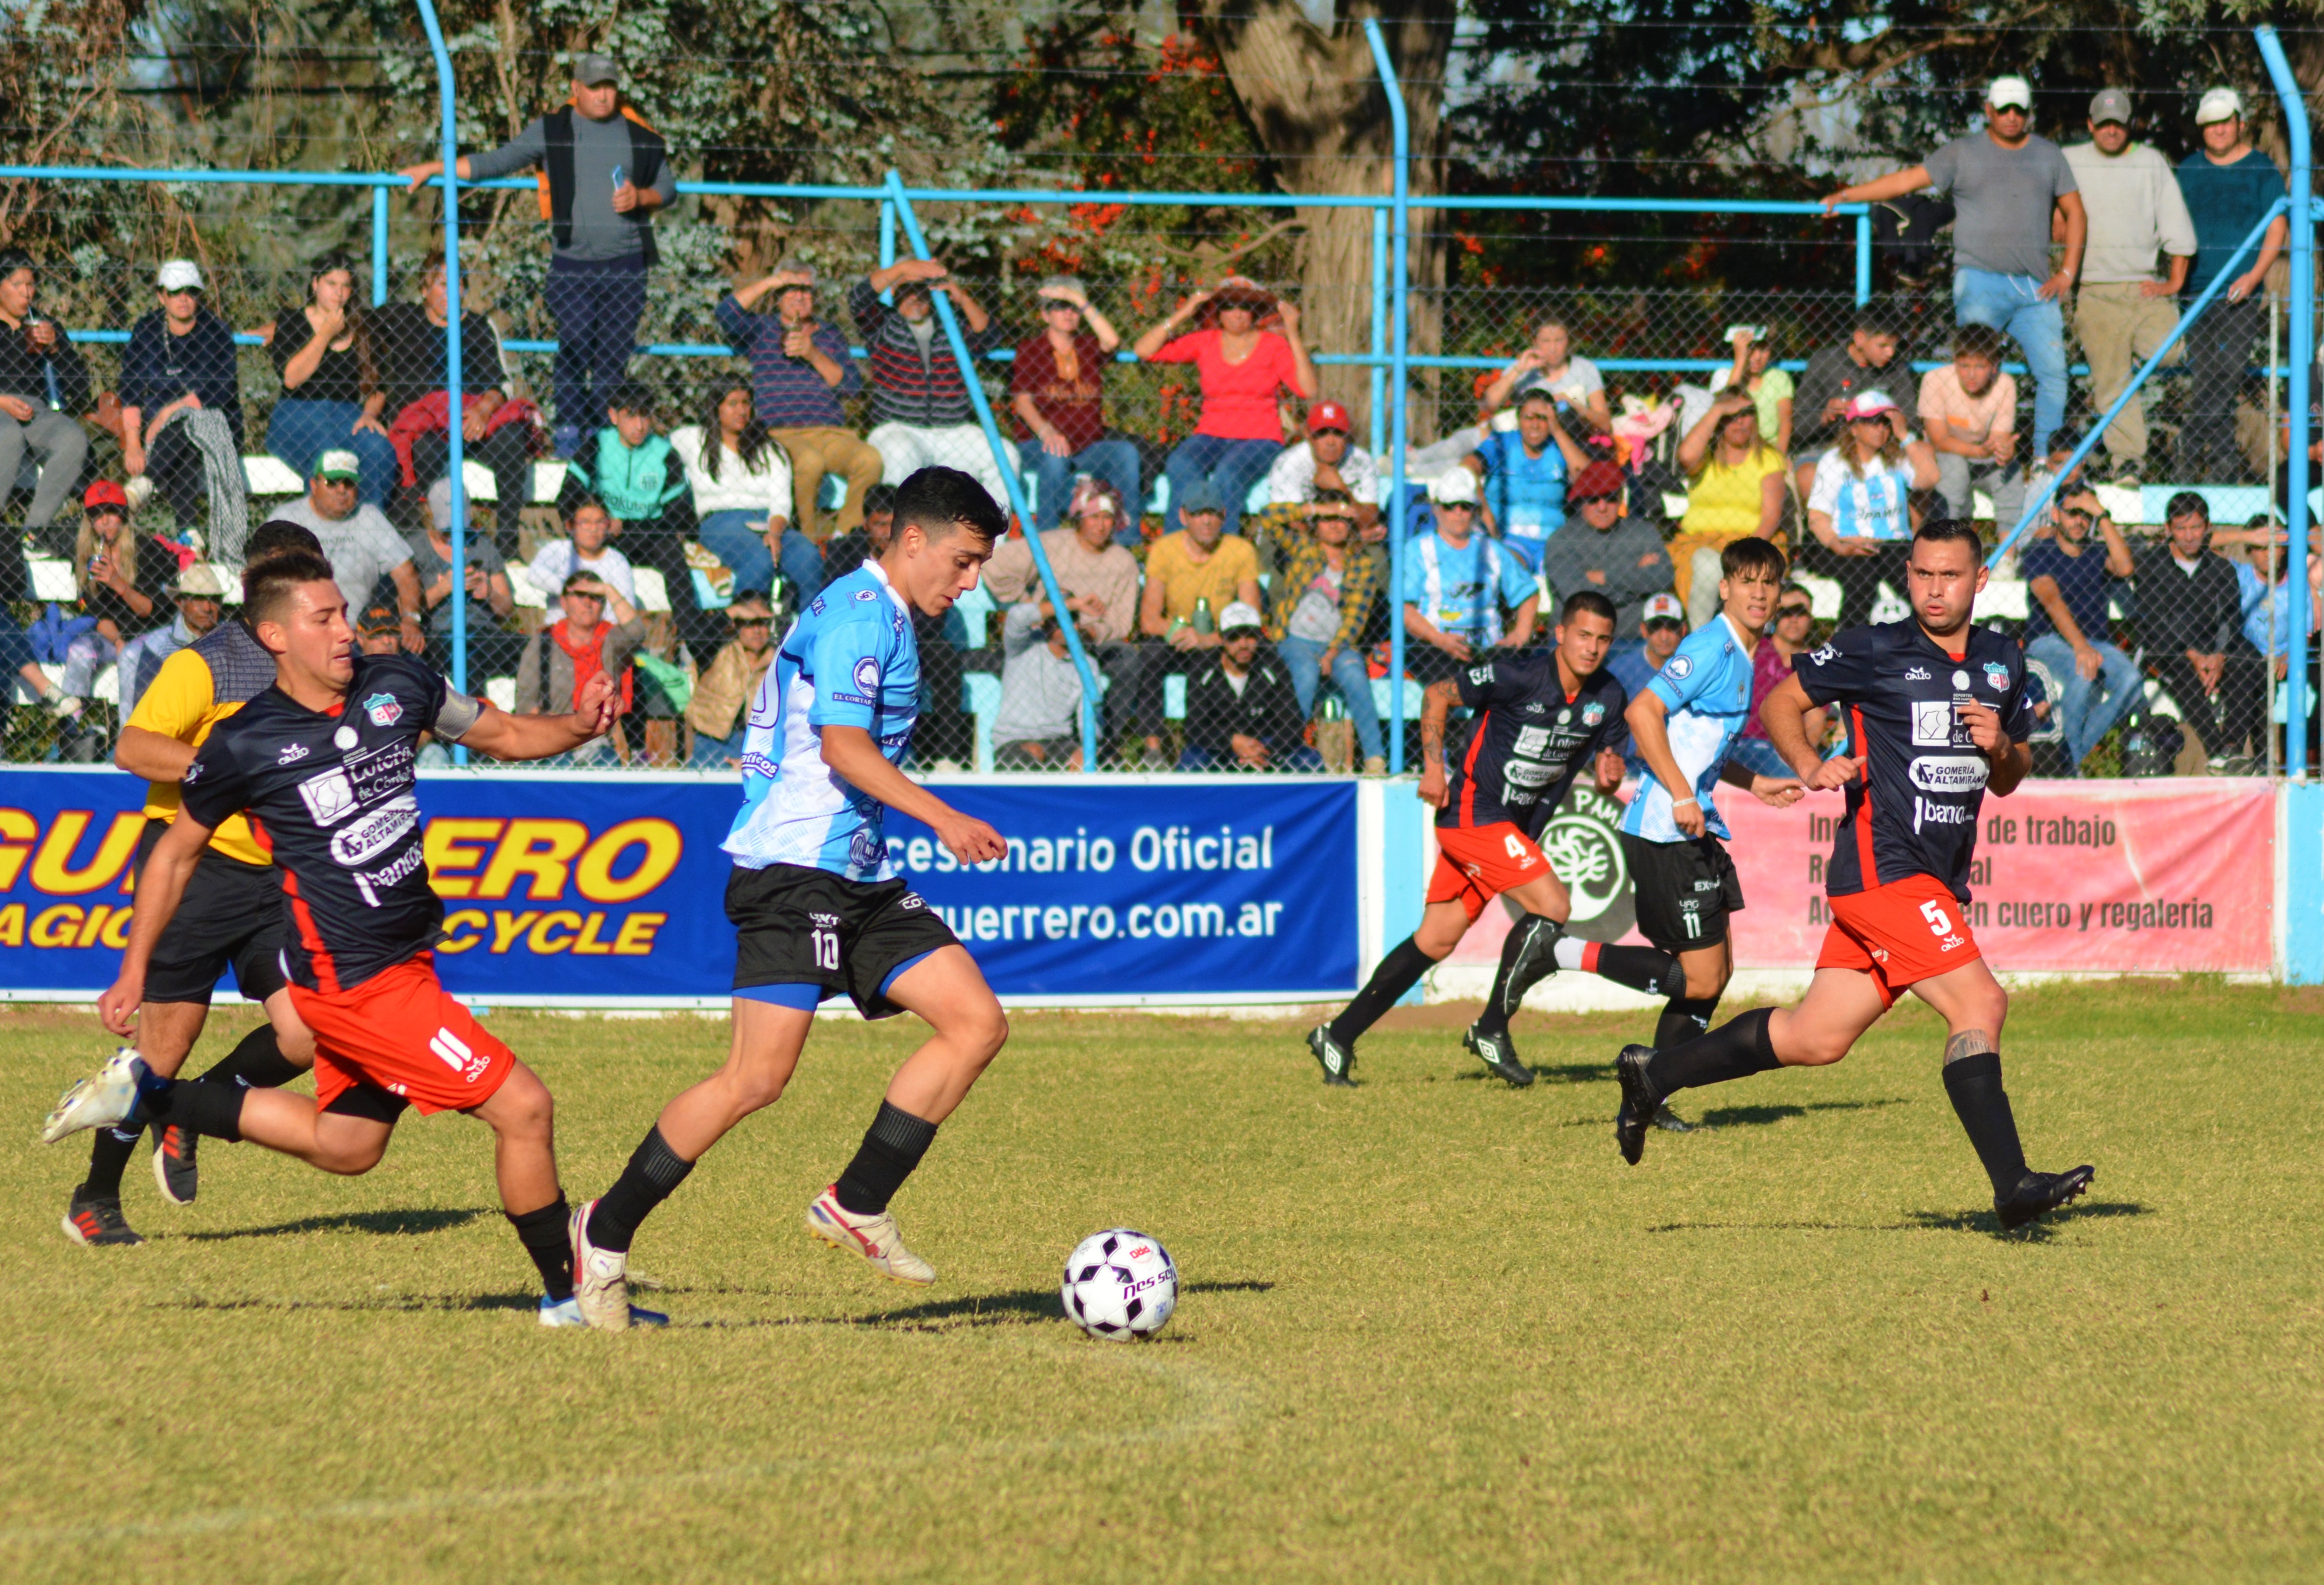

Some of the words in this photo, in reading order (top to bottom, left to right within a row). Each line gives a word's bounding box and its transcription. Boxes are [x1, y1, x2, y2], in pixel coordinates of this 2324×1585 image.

[1504, 834, 1527, 858] 4
[1987, 814, 2017, 845] de
[2026, 814, 2116, 848] trabajo
[1131, 825, 1273, 872] Oficial
[1683, 913, 1701, 939] 11
[1919, 899, 1952, 936] 5
[1997, 901, 2071, 928] cuero
[2078, 902, 2093, 932] y
[811, 929, 839, 970] 10
